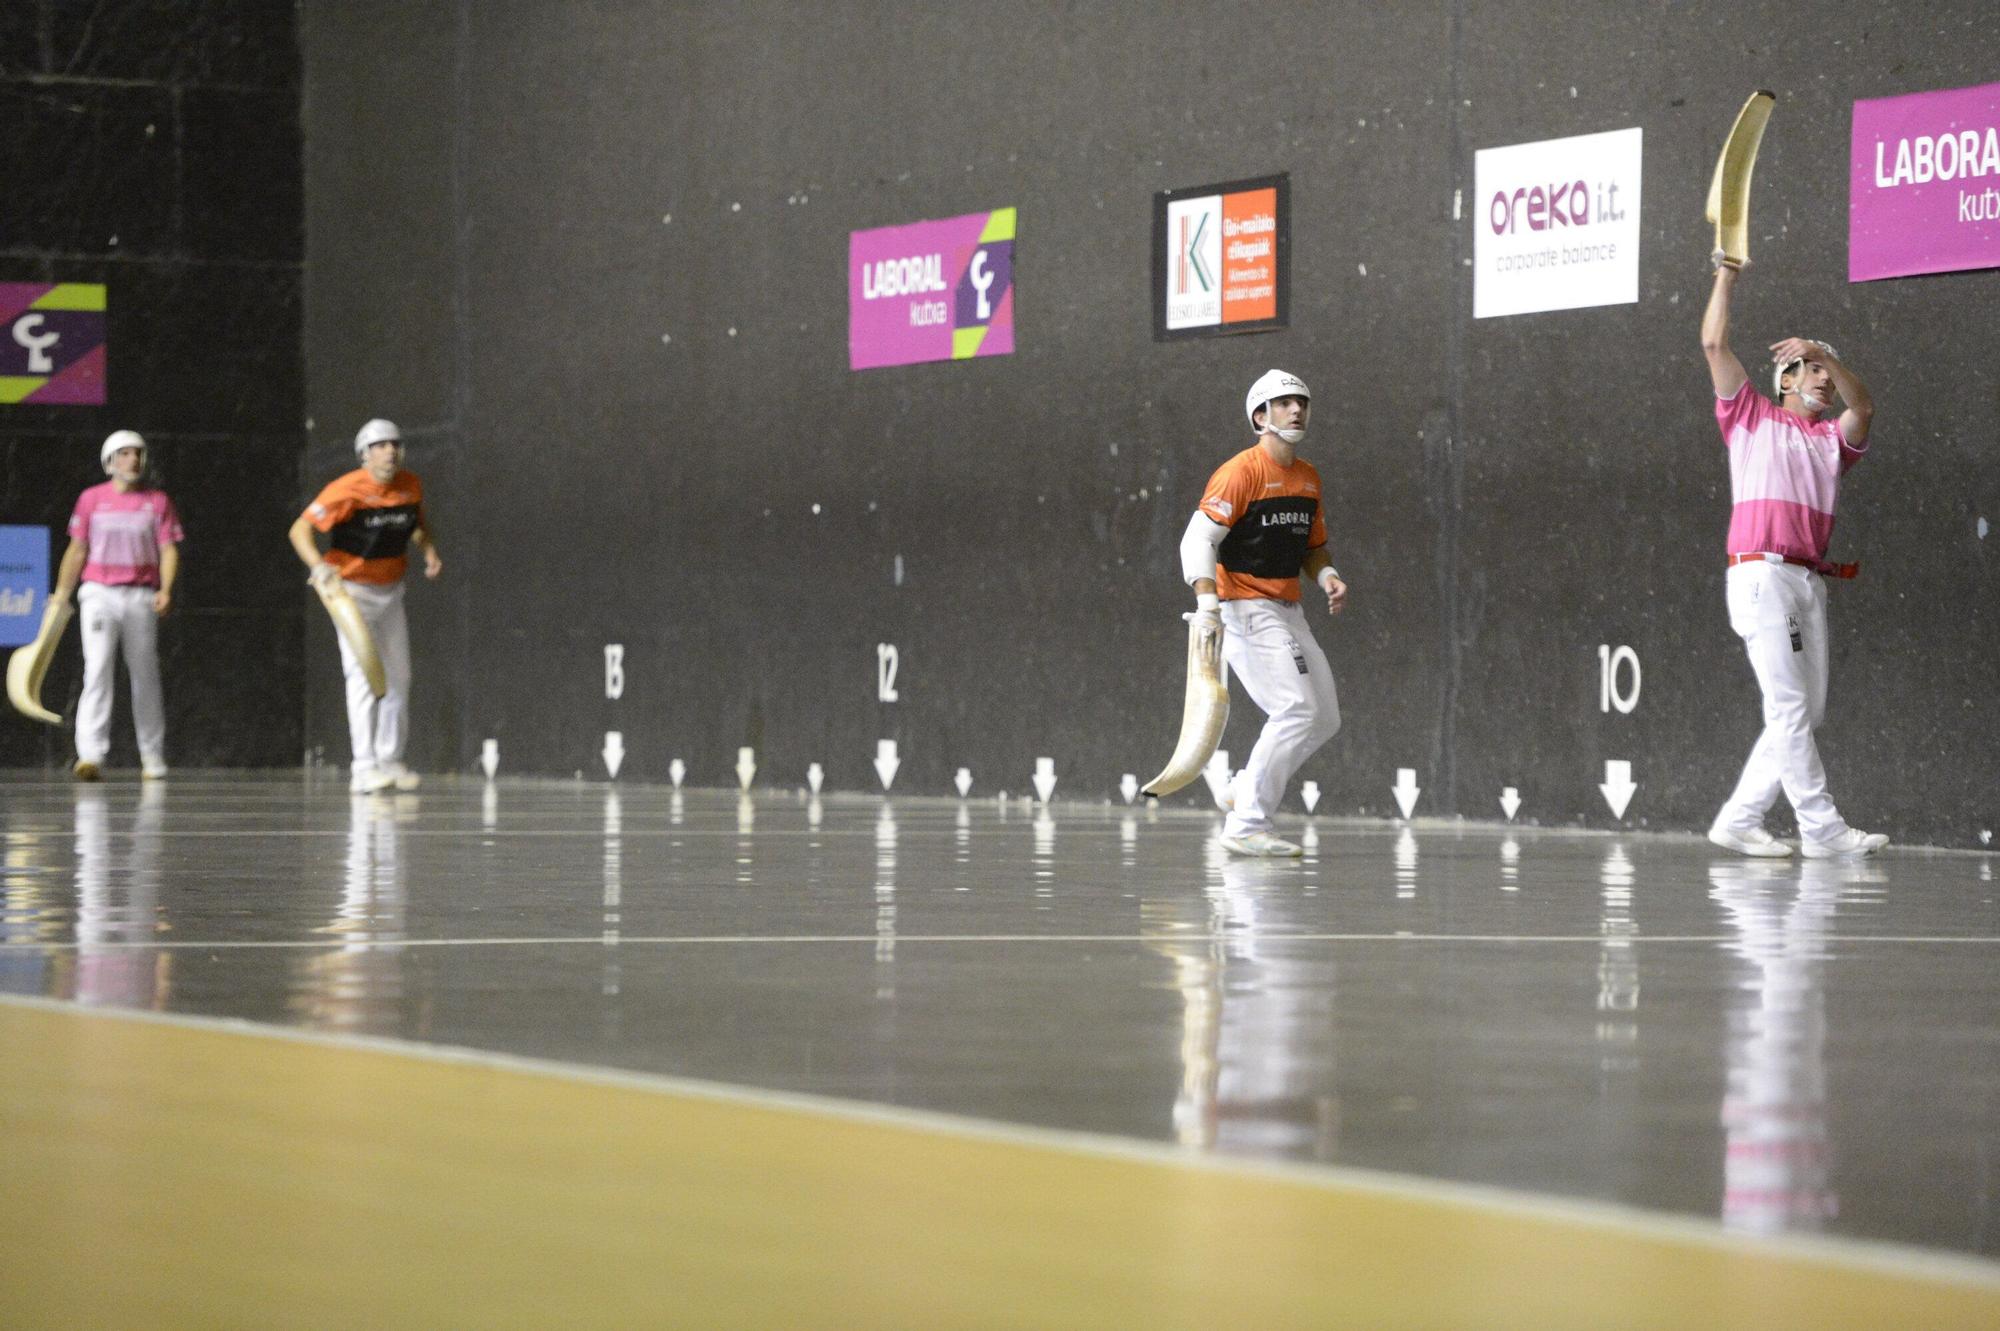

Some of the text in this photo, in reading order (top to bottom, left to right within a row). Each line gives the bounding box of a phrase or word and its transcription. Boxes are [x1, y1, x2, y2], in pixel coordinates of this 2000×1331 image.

[1876, 127, 2000, 188] LABORA
[1490, 180, 1589, 235] oreka
[864, 253, 947, 299] LABORAL
[1496, 242, 1617, 275] corporate balance
[1261, 511, 1310, 527] LABORAL
[877, 642, 899, 702] 12
[1598, 643, 1641, 714] 10
